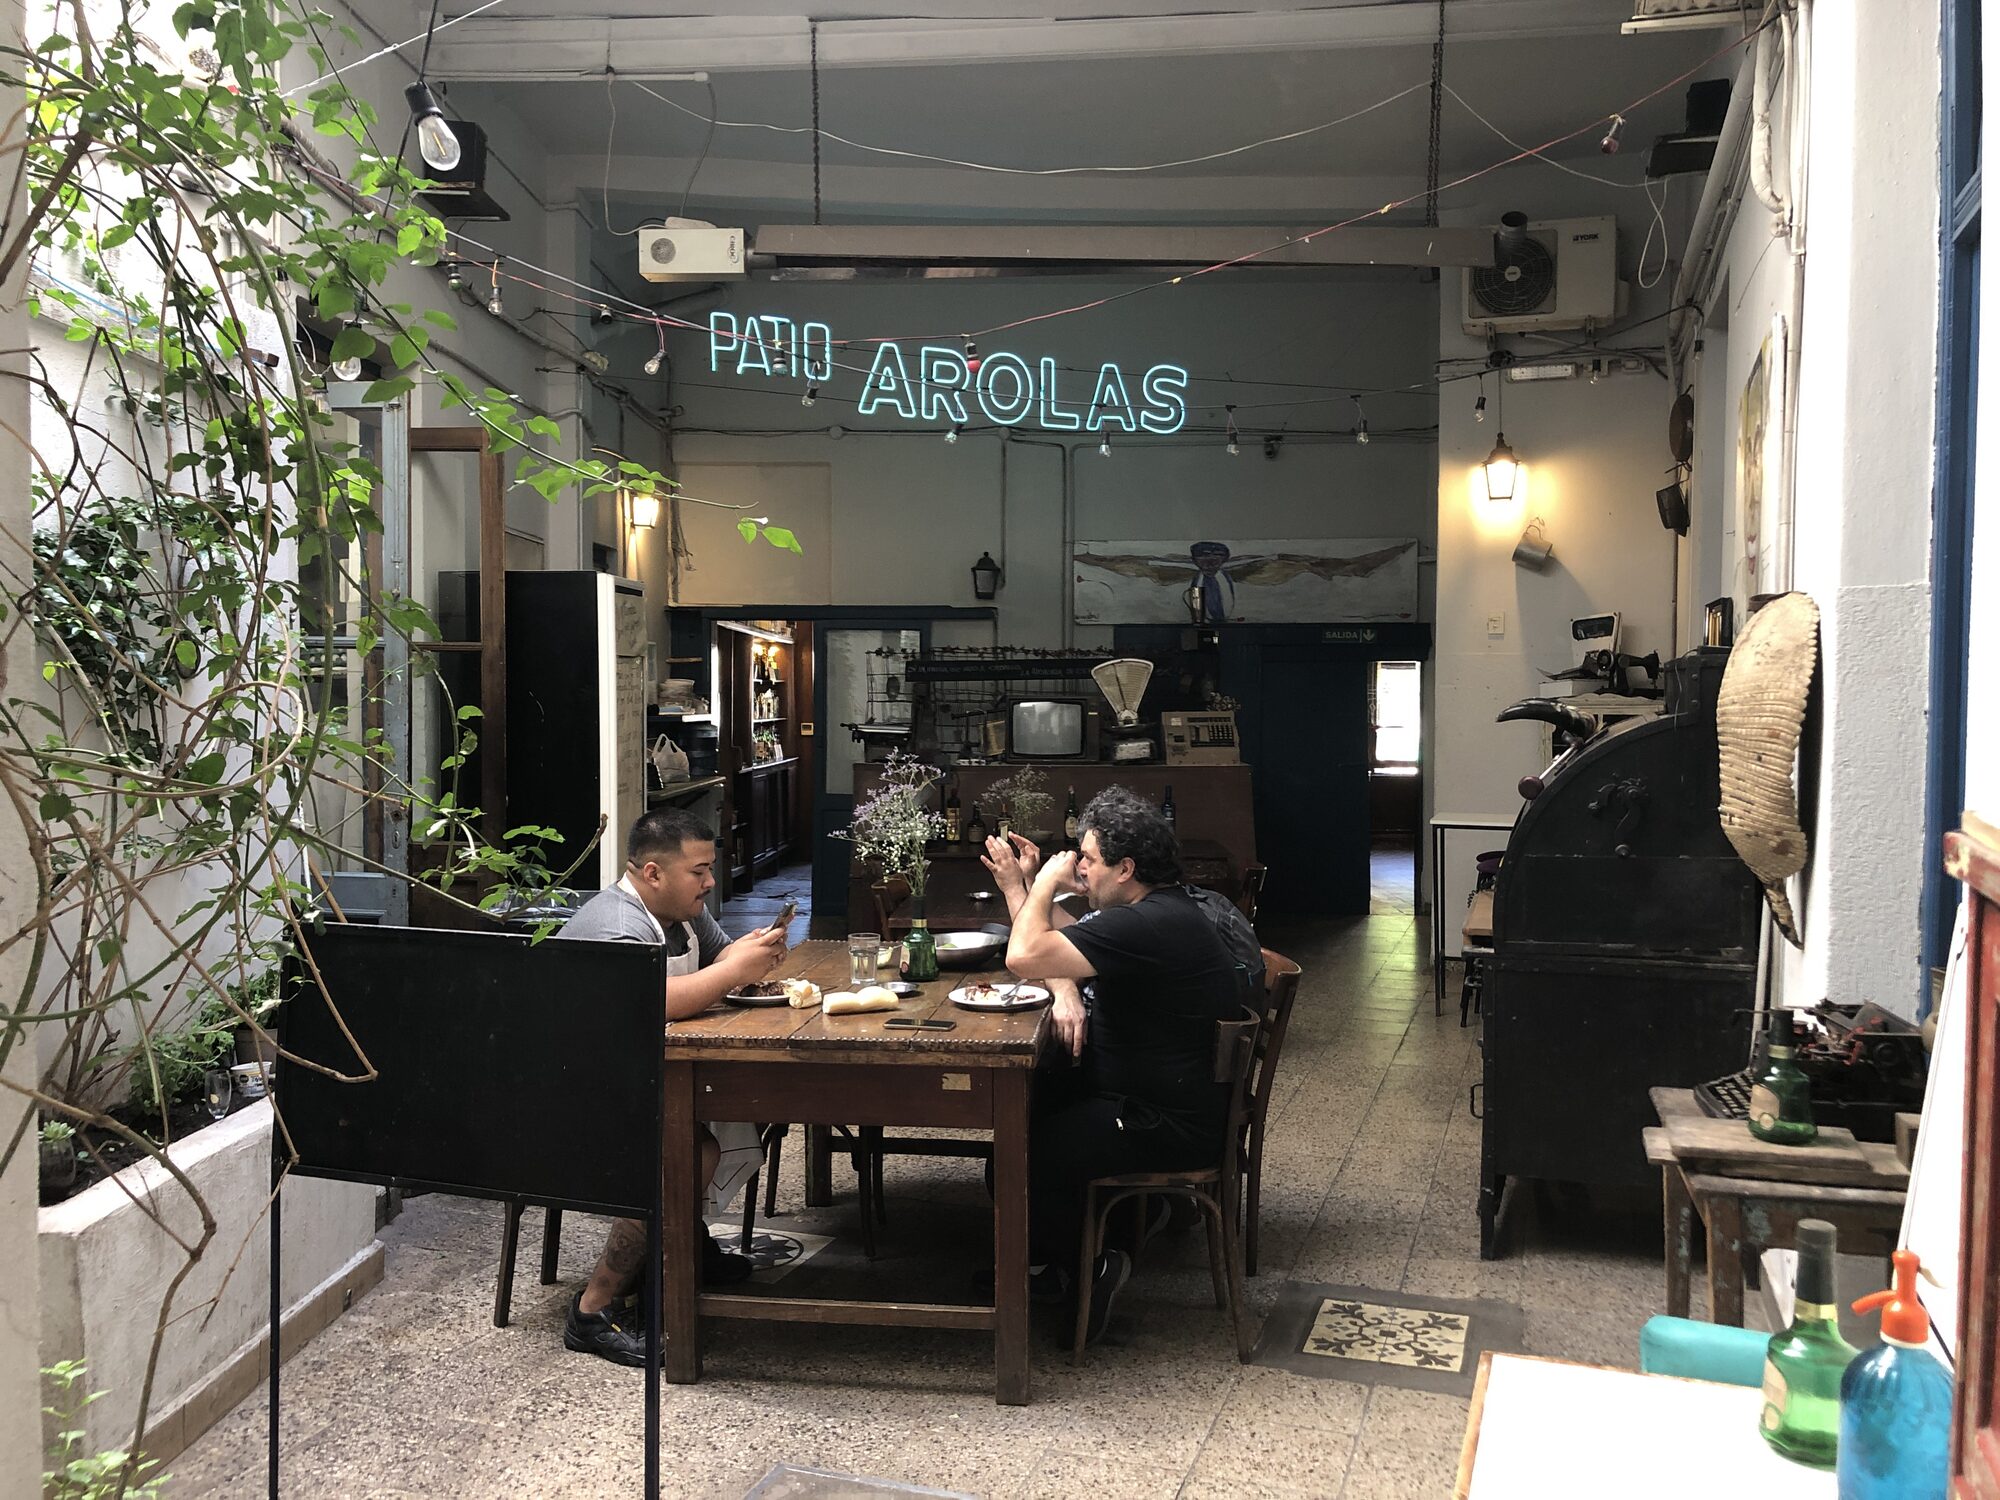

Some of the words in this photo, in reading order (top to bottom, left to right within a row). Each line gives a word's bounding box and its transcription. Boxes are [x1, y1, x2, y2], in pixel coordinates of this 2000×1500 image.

[710, 311, 832, 382] PATIO
[857, 341, 1188, 435] AROLAS
[1325, 631, 1359, 640] SALIDA
